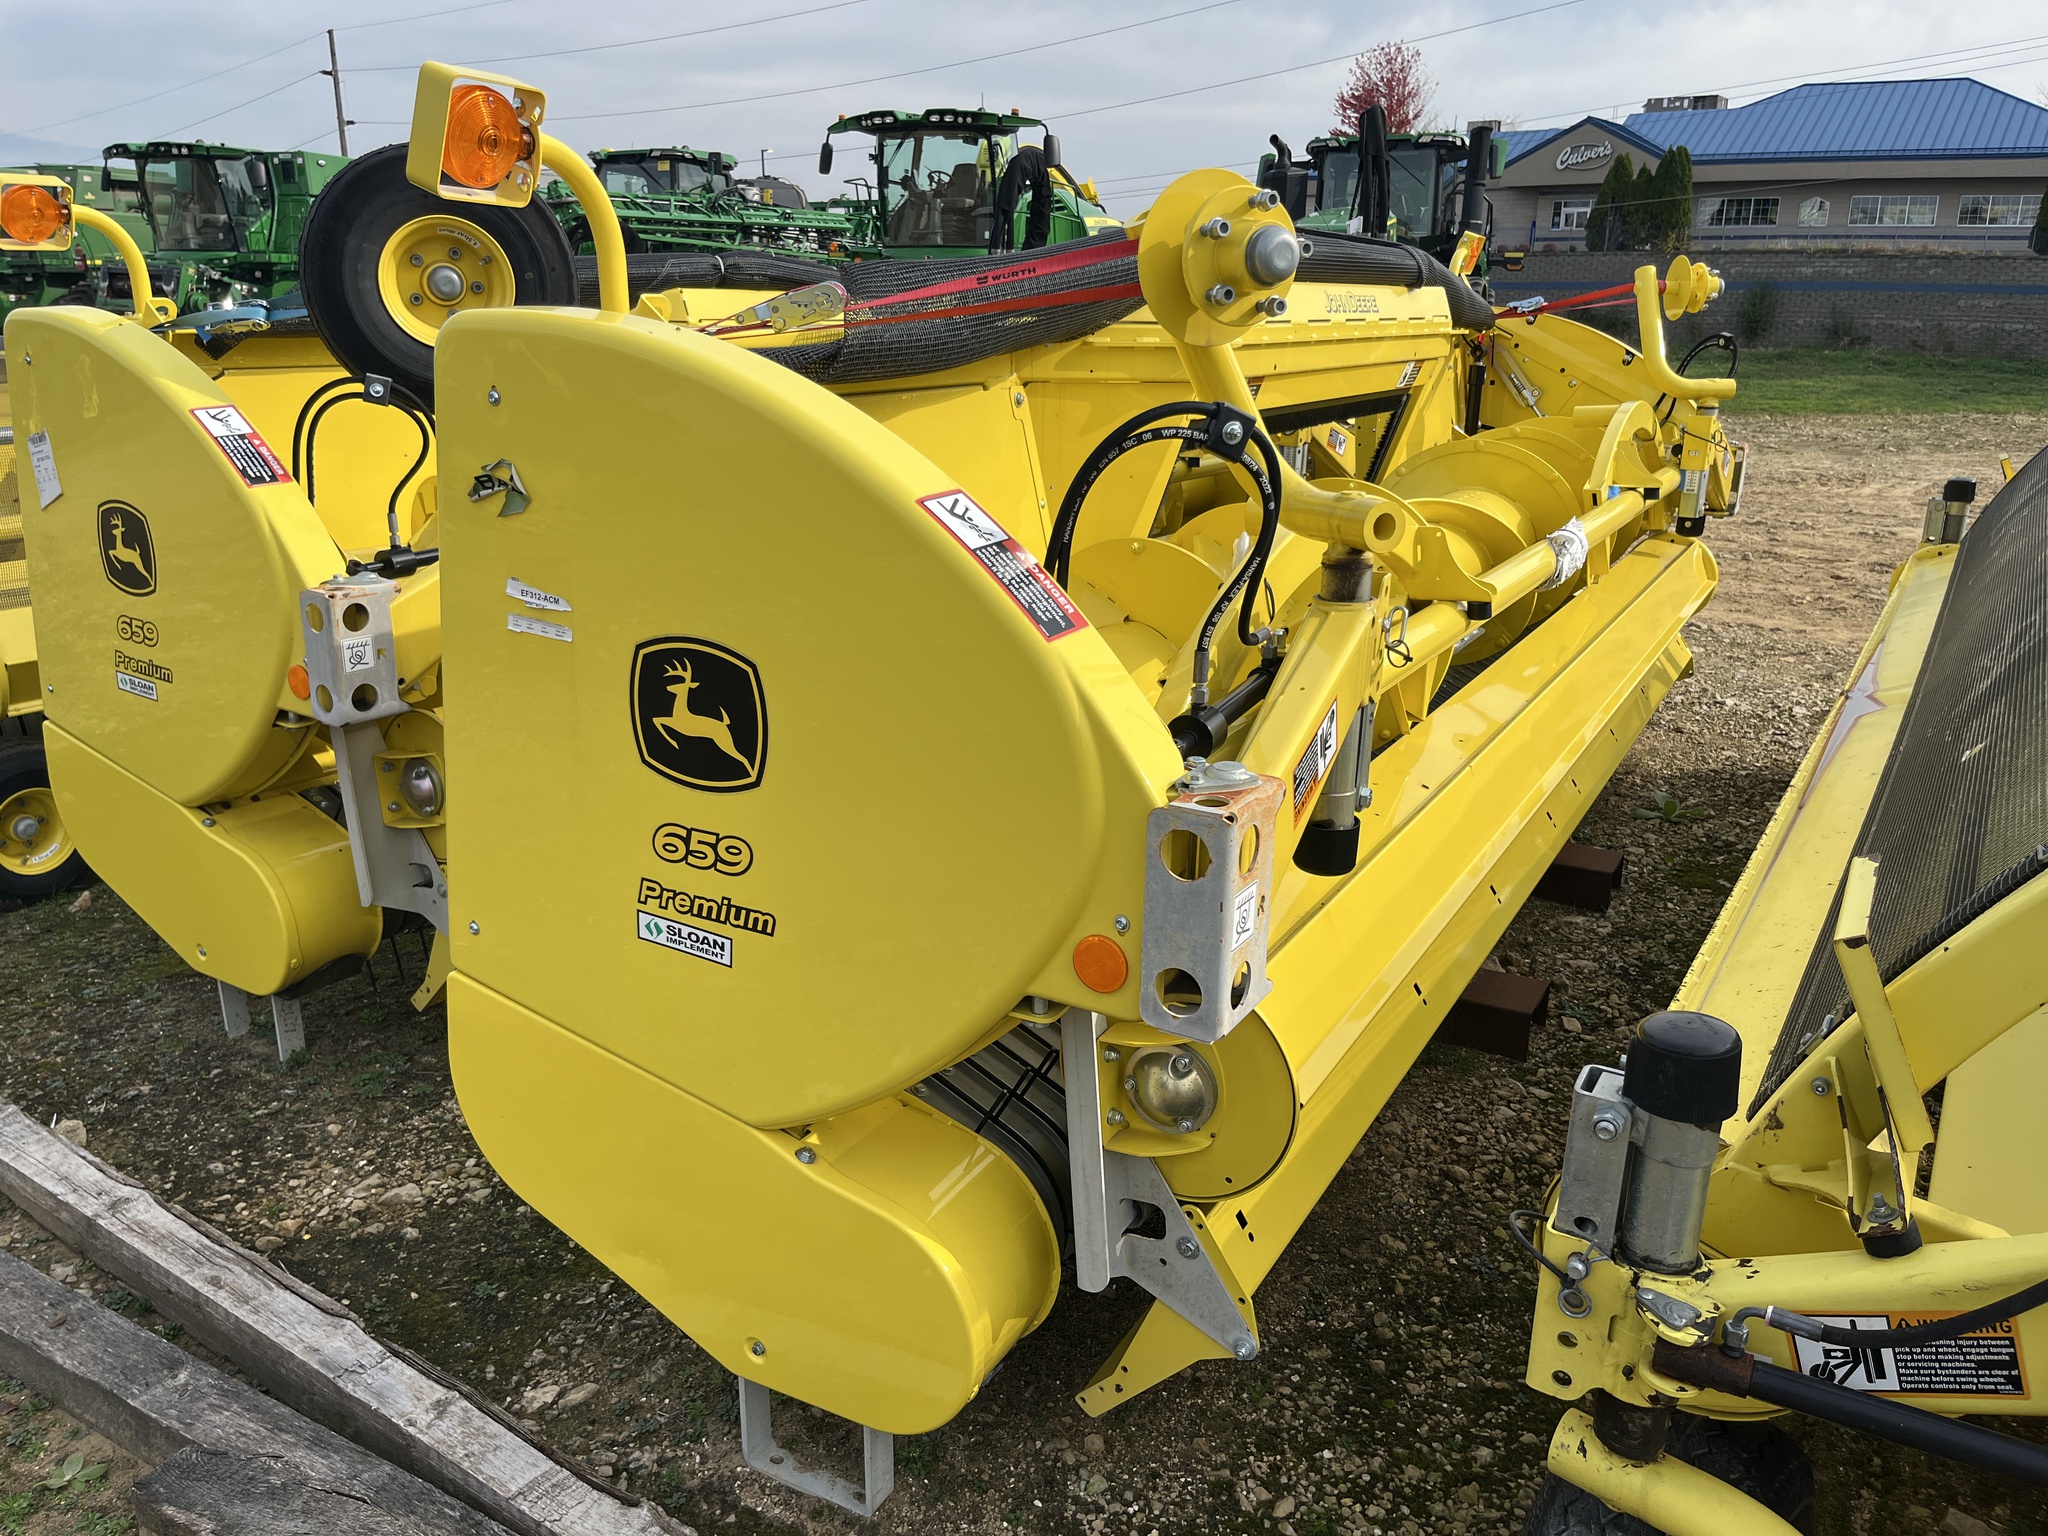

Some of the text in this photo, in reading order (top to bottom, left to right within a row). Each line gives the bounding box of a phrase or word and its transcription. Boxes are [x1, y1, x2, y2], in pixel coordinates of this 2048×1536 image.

[1555, 140, 1613, 170] Culver's
[991, 267, 1037, 282] WÜRTH
[1347, 291, 1380, 313] DEERE
[1108, 447, 1120, 460] 857
[1121, 437, 1138, 450] 1SC
[1142, 432, 1153, 441] 06
[1161, 429, 1176, 438] WP
[1177, 429, 1192, 438] 225
[259, 446, 285, 475] DANGER
[976, 550, 992, 567] when
[1009, 585, 1029, 609] motion.
[981, 548, 1005, 573] clothing
[1010, 580, 1019, 588] be
[1019, 589, 1033, 603] near
[1031, 603, 1049, 622] auger
[986, 546, 996, 555] do
[995, 555, 1006, 566] not
[1005, 566, 1021, 582] allow
[1020, 583, 1046, 611] person(s)
[1045, 611, 1053, 619] or
[999, 552, 1016, 569] death
[1015, 570, 1029, 584] from
[1028, 585, 1066, 628] entanglement.
[1006, 551, 1064, 616] To avoid serious injury
[1030, 564, 1075, 614] DANGER
[1228, 556, 1261, 599] HANSA-FLEX
[520, 588, 560, 605] EF312-ACM
[1220, 600, 1230, 612] KP
[117, 614, 159, 648] 659
[1201, 637, 1210, 649] 857
[1206, 625, 1214, 637] EN
[114, 648, 174, 684] Premium
[377, 648, 387, 660] R
[128, 678, 154, 692] SLOAN
[652, 822, 754, 877] 659
[637, 876, 777, 938] Premium
[665, 924, 726, 953] SLOAN
[665, 936, 726, 961] IMPLEMENT
